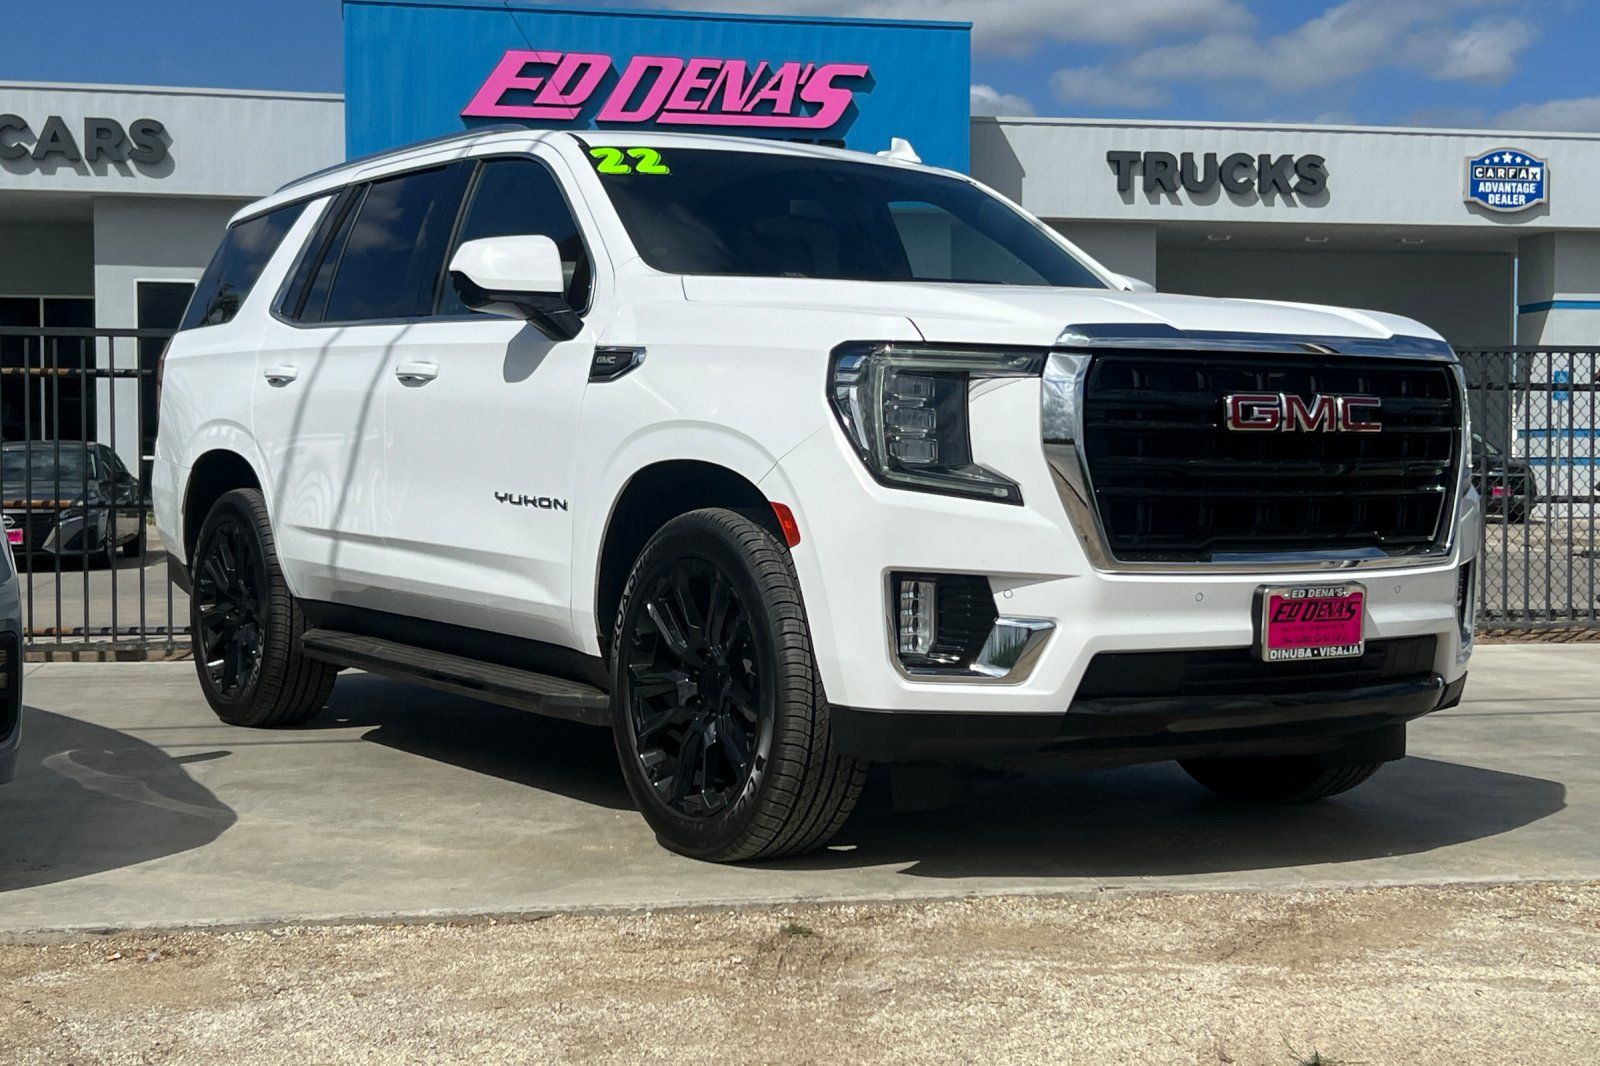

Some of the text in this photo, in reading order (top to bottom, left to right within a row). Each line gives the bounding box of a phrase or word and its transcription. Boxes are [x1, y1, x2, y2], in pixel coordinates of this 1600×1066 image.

[0, 114, 167, 164] CARS
[589, 146, 670, 175] 22
[1106, 150, 1328, 195] TRUCKS
[1475, 167, 1539, 181] CARFAX
[1478, 182, 1537, 193] ADVANTAGE
[1488, 194, 1526, 205] DEALER
[596, 356, 617, 364] GMC
[1225, 393, 1382, 433] GMC
[494, 491, 569, 511] YUKON
[1292, 588, 1344, 598] ED DENA'S
[1269, 645, 1360, 660] DINUBA VISALIA
